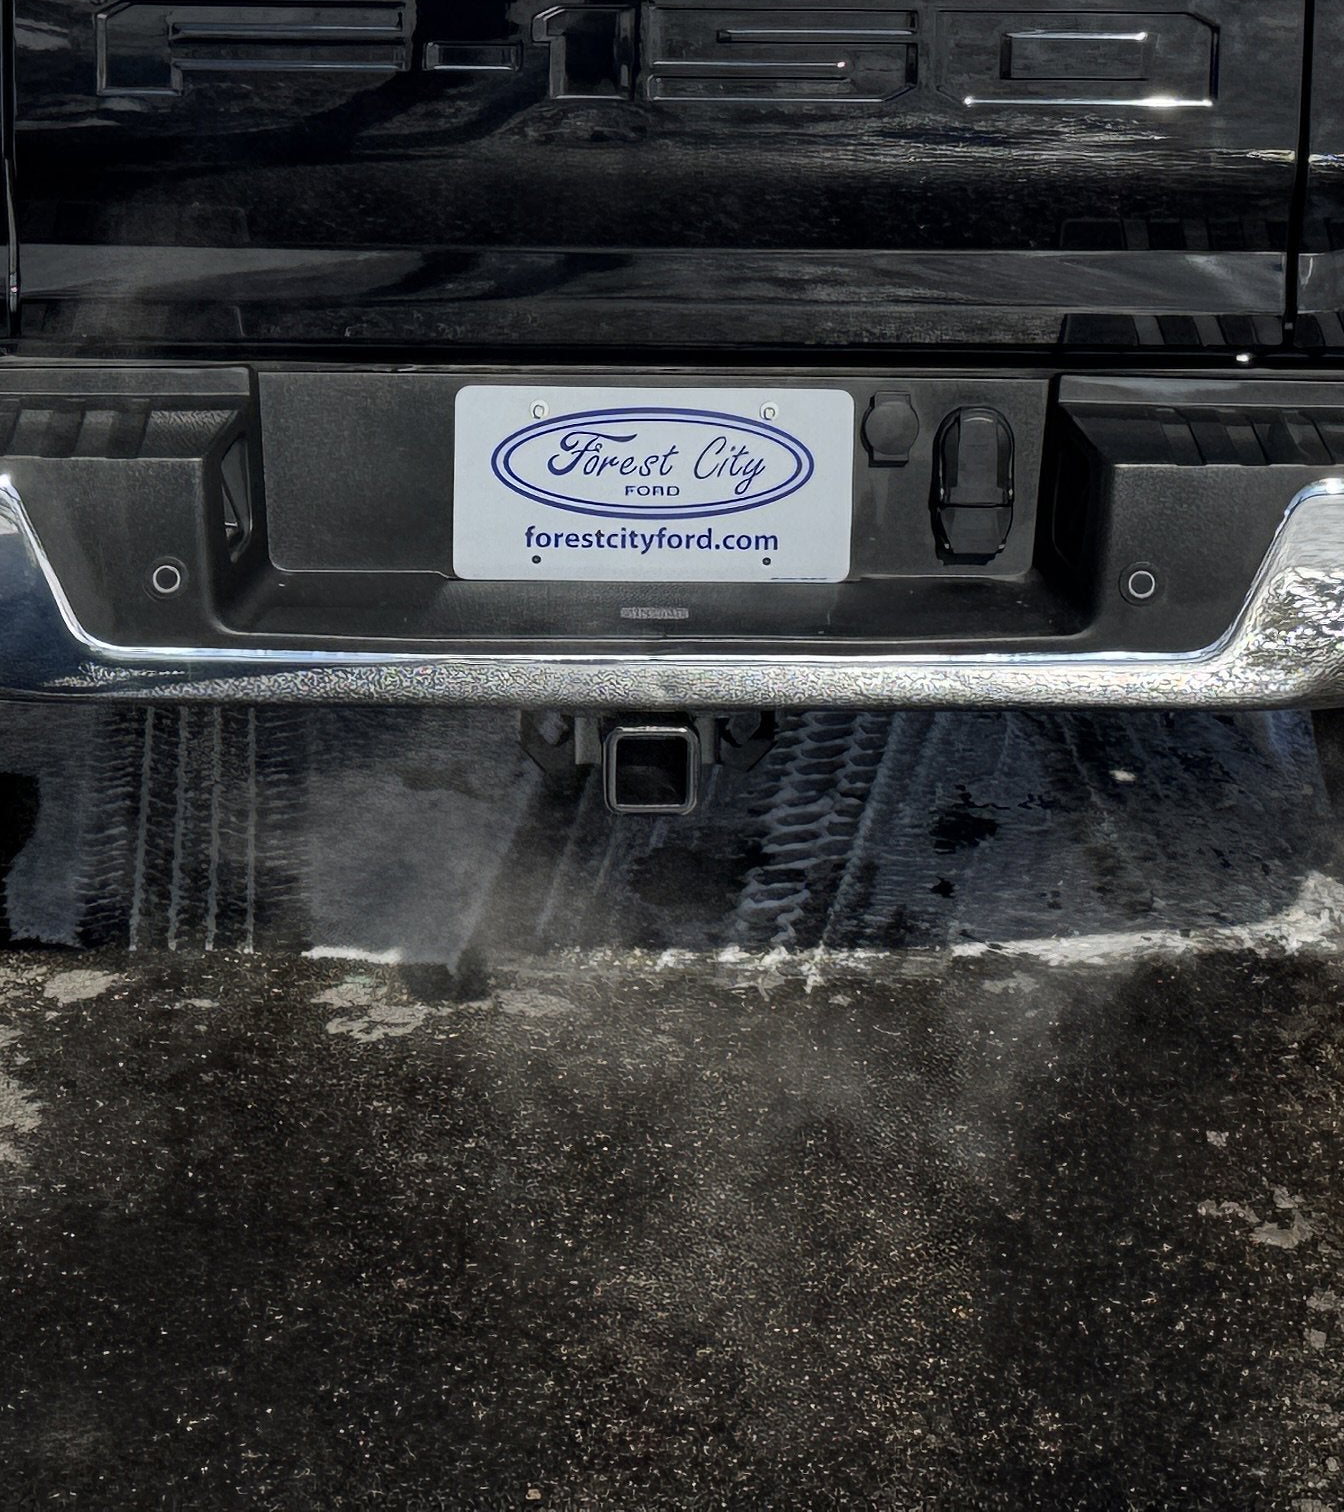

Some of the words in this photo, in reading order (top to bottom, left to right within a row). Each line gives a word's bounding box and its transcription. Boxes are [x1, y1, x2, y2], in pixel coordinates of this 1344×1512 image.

[546, 430, 680, 478] Forest
[694, 435, 767, 495] City
[624, 485, 680, 497] FORD
[524, 525, 779, 555] forestcityford.com
